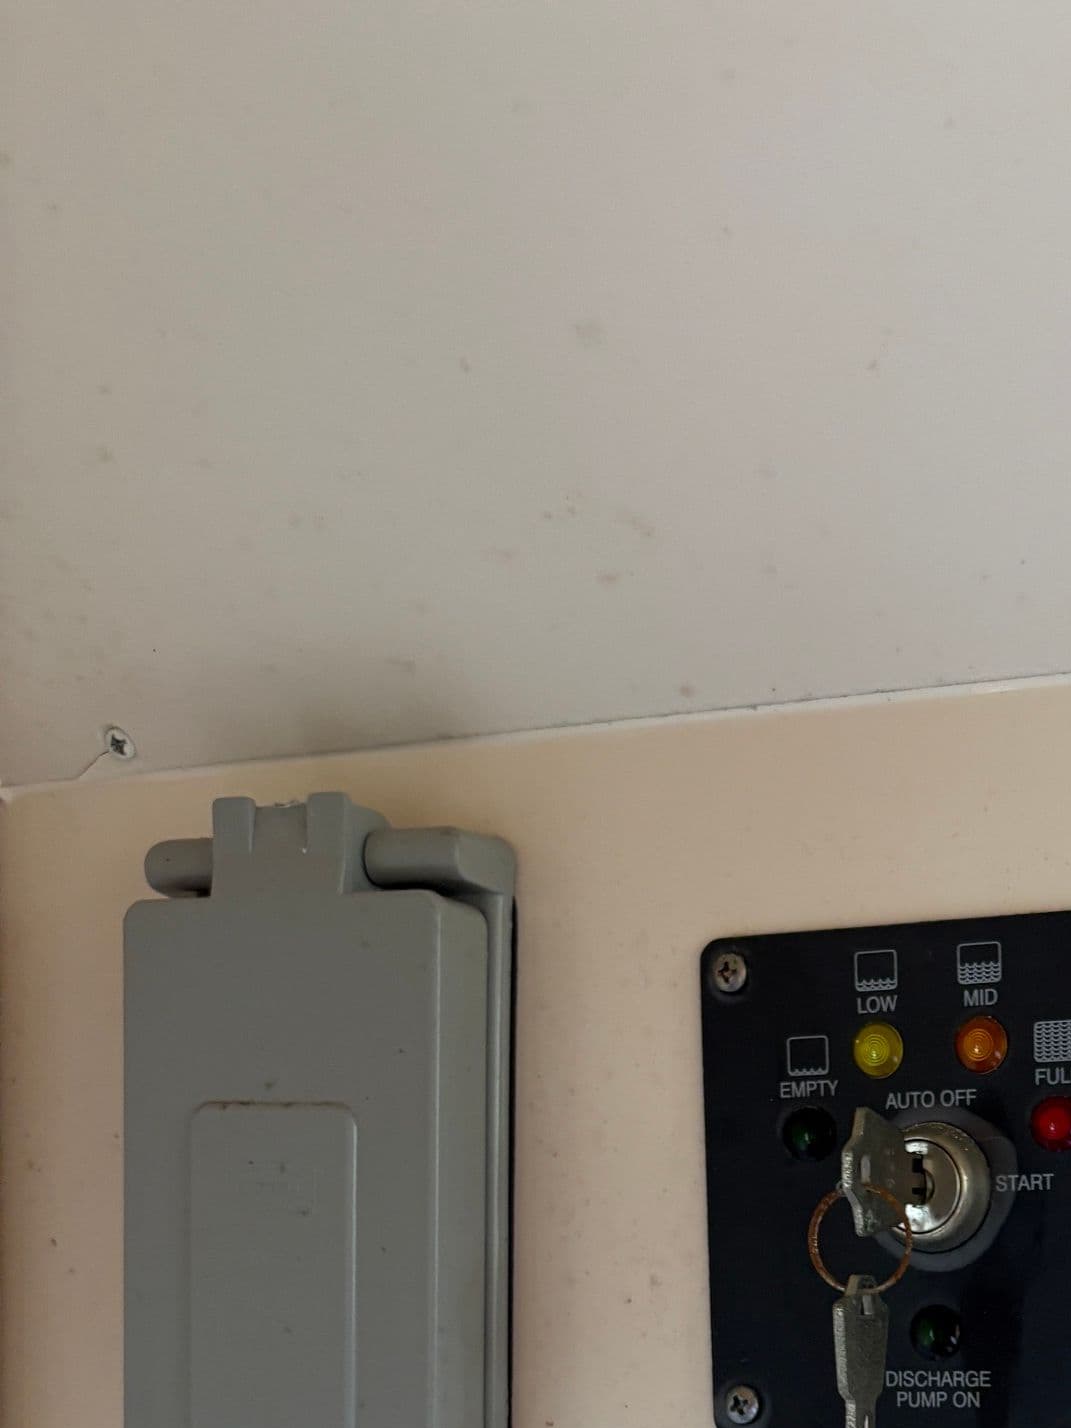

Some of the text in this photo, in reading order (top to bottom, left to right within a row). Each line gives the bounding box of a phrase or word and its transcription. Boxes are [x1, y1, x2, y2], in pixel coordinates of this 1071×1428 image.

[857, 995, 898, 1014] LOW
[963, 989, 998, 1007] MID
[780, 1079, 838, 1098] EMPTY
[886, 1089, 977, 1109] AUTO OFF
[995, 1174, 1054, 1192] START
[885, 1370, 991, 1388] DISCHARGE
[897, 1391, 981, 1408] PUMP ON
